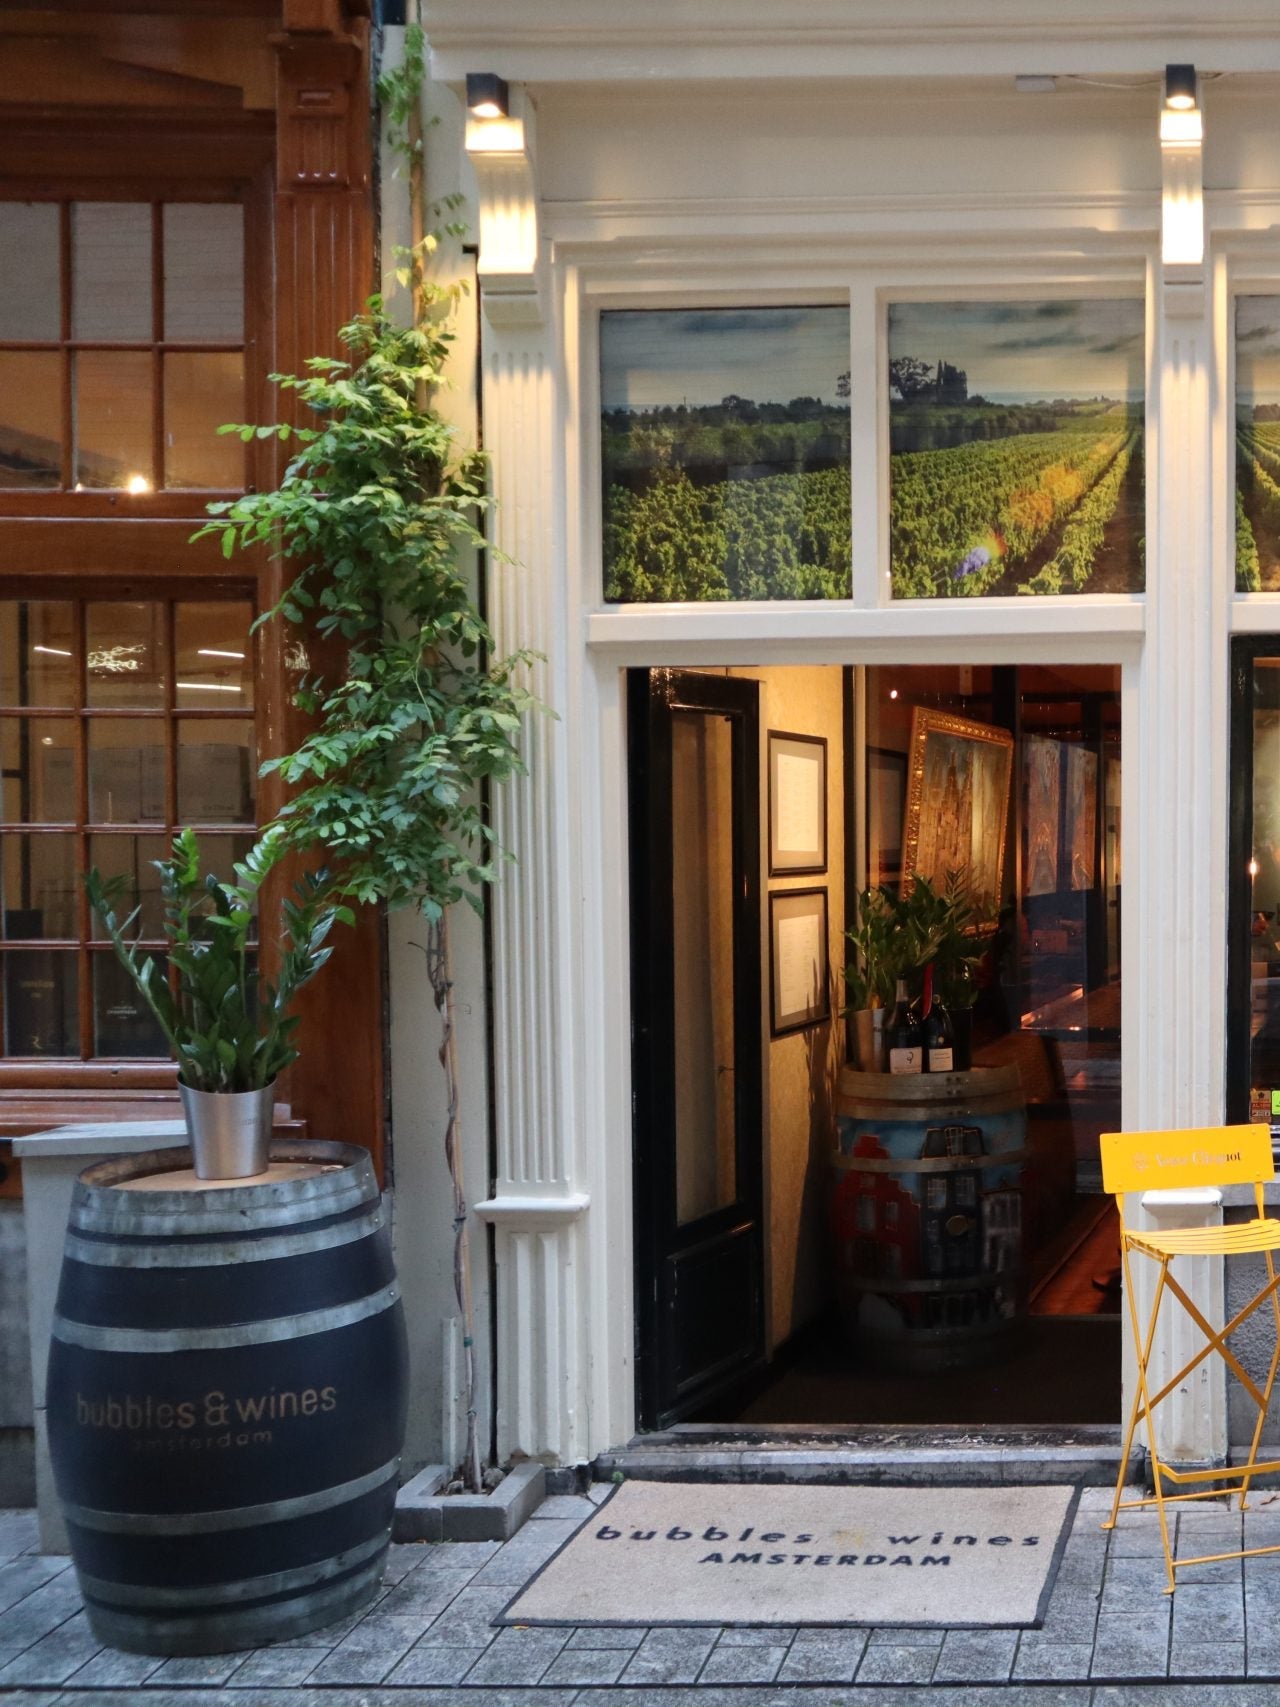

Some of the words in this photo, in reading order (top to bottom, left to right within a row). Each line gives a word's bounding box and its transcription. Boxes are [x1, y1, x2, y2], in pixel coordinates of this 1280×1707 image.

[76, 1391, 197, 1430] bubbles
[235, 1385, 338, 1424] wines
[595, 1525, 815, 1545] bubbles
[886, 1530, 1041, 1548] wines
[699, 1551, 952, 1567] AMSTERDAM
